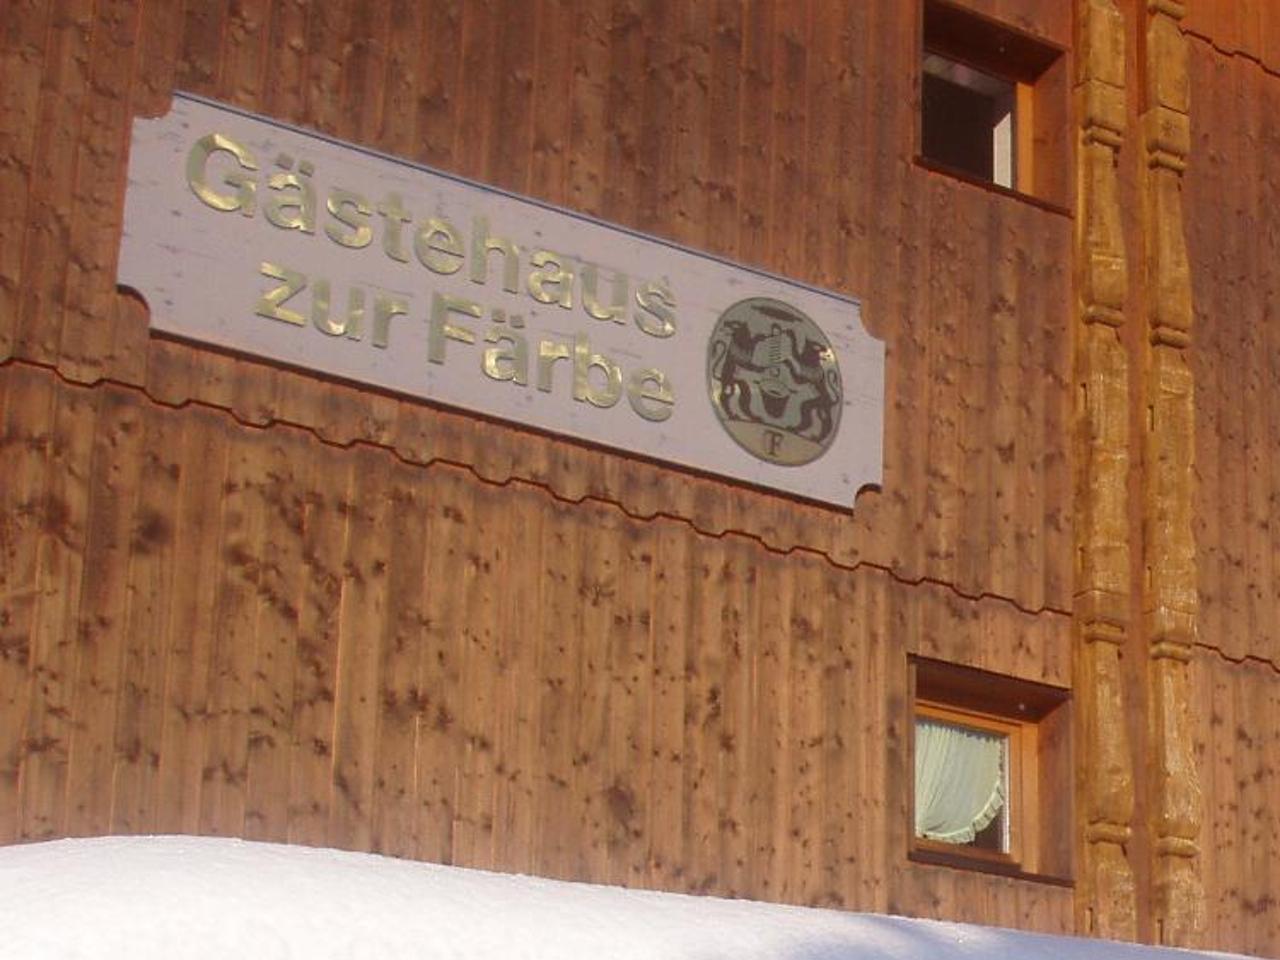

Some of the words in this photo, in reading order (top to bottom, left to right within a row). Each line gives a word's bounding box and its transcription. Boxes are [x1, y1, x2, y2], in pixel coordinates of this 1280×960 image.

[186, 133, 677, 339] Gästehaus
[254, 261, 409, 349] zur
[428, 291, 675, 422] Färbe
